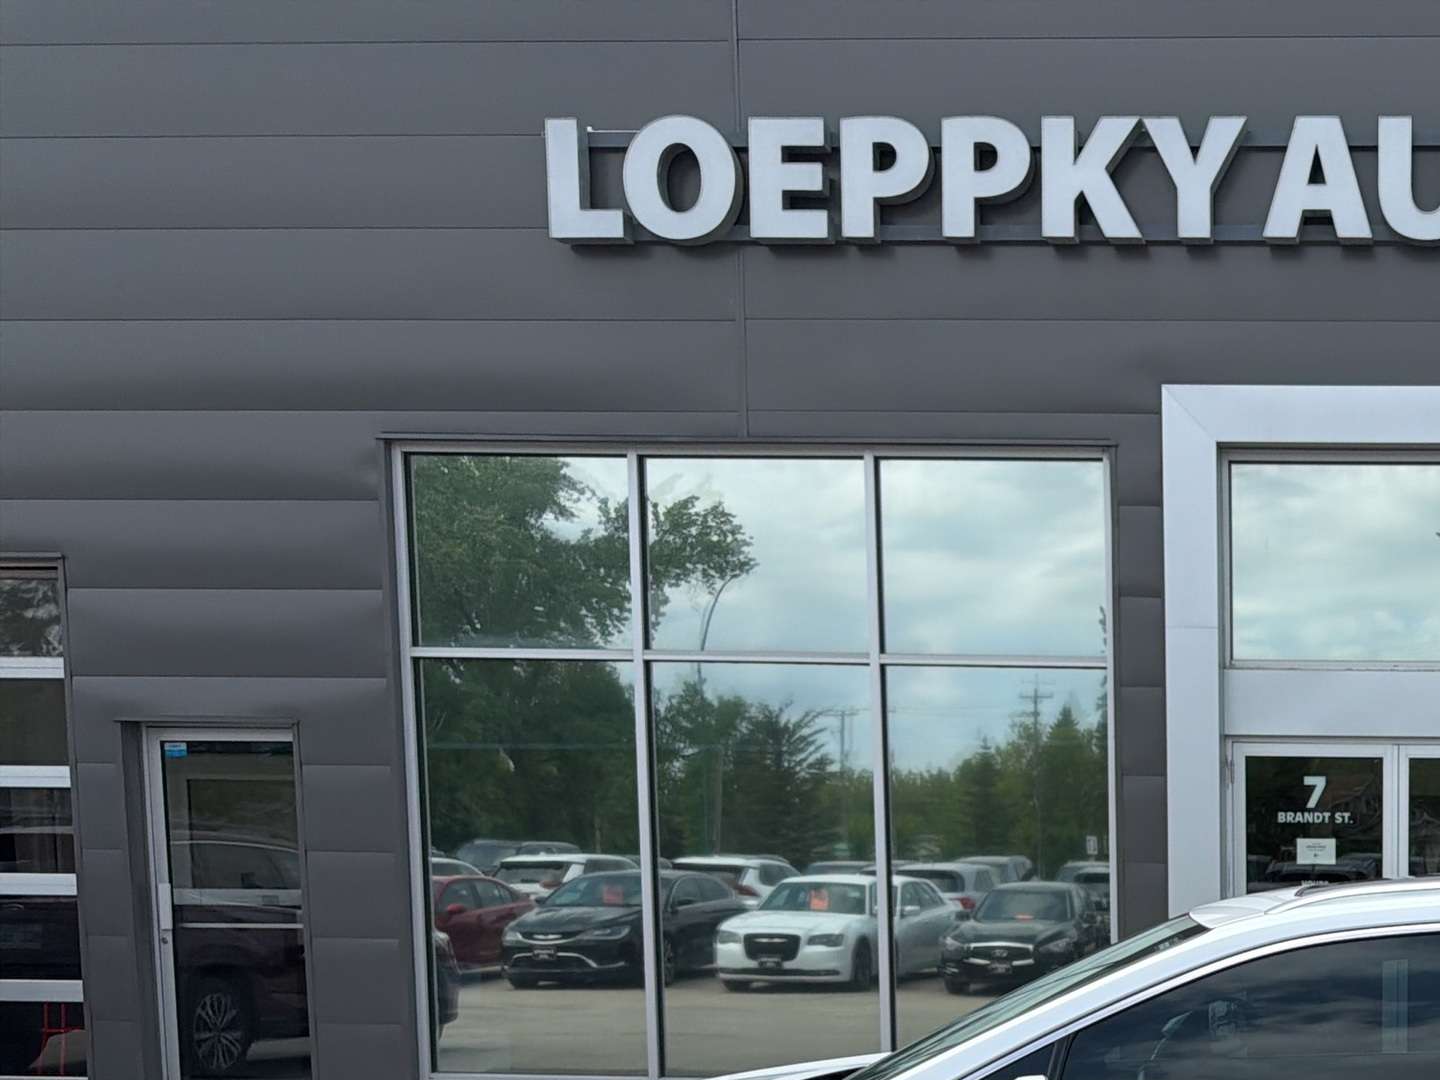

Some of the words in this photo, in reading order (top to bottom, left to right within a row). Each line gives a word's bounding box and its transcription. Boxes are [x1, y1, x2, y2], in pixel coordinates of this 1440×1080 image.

[543, 115, 1248, 243] LOEPPKY
[1303, 775, 1327, 809] 7
[1277, 811, 1331, 824] BRANDT
[1334, 811, 1354, 824] ST.
